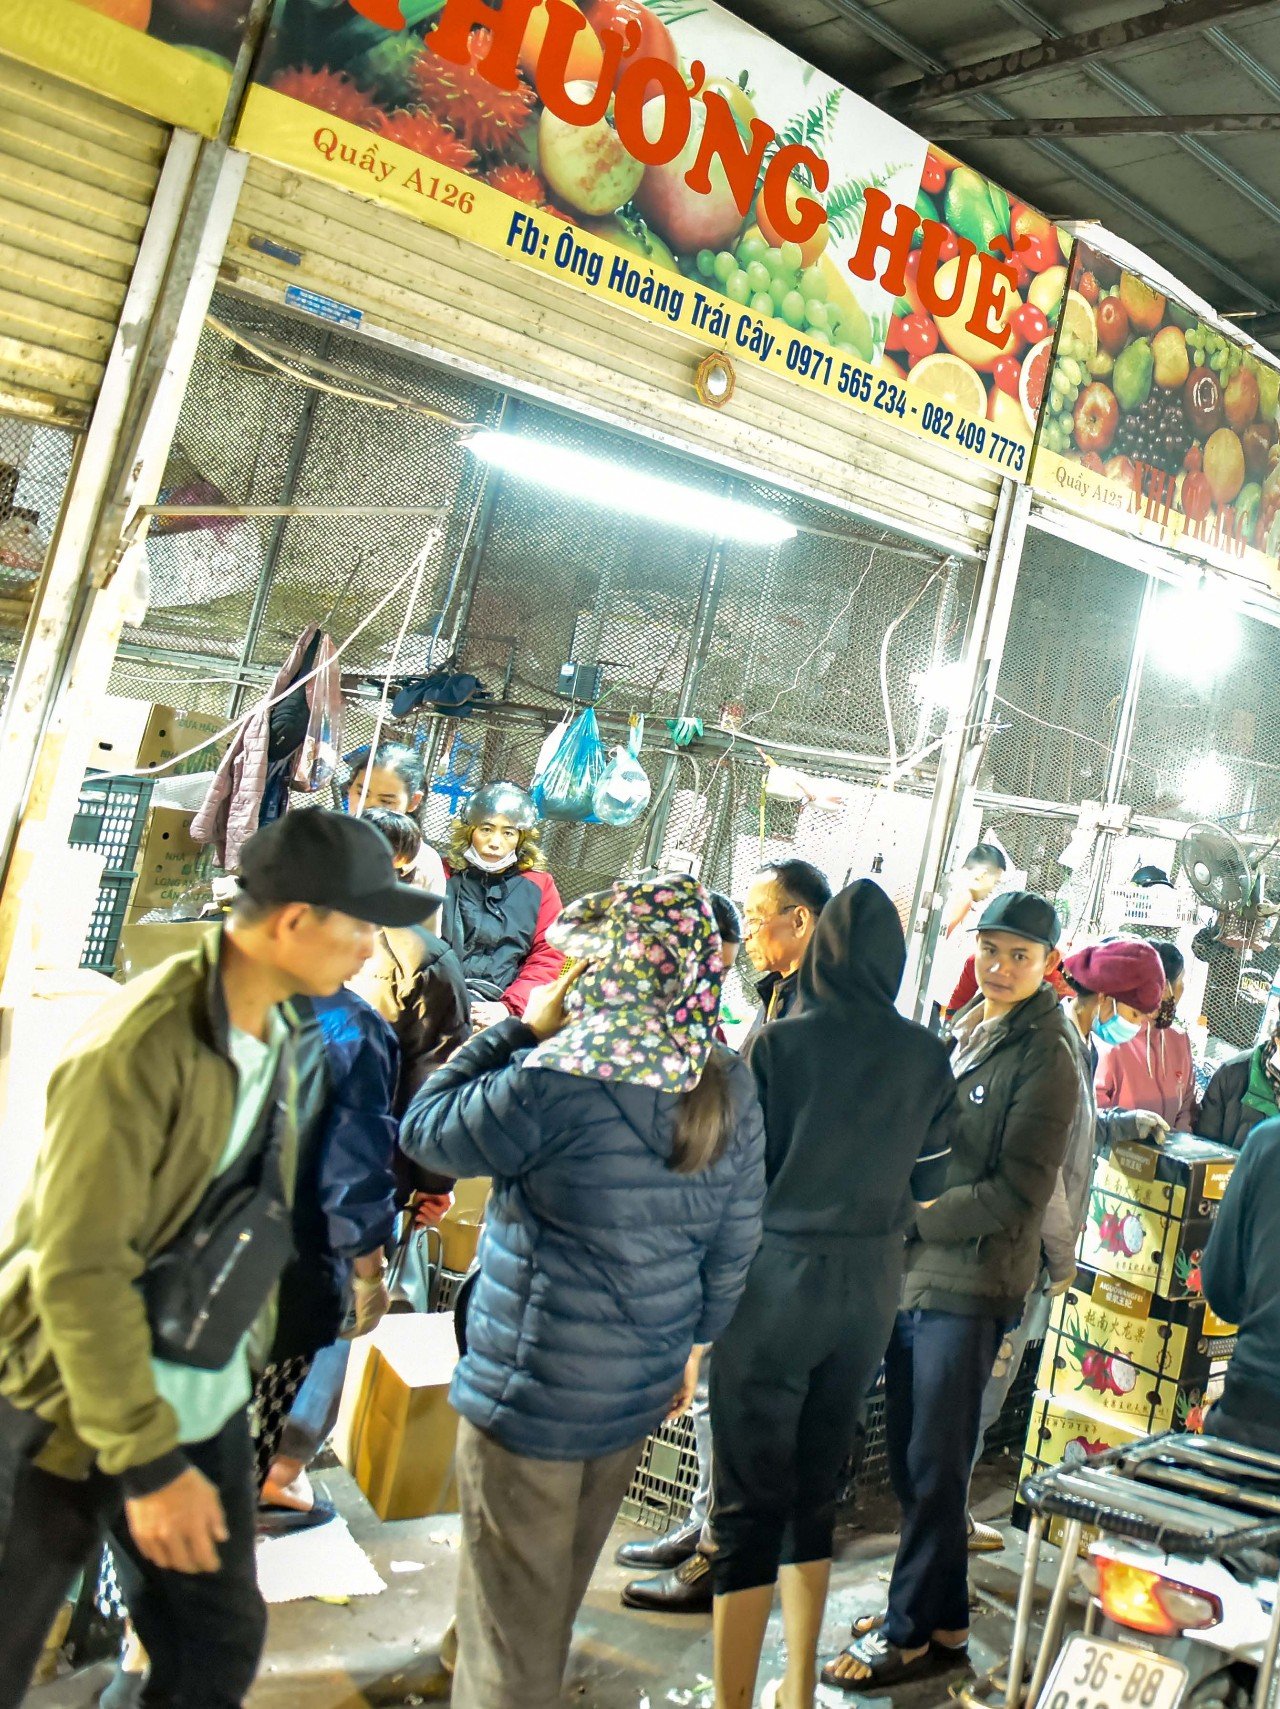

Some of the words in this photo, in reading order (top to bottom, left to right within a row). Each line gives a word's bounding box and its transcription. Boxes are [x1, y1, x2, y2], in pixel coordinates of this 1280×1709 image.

[347, 0, 829, 244] HƯƠNG
[313, 126, 397, 182] Quầy
[402, 168, 476, 215] A126
[506, 210, 550, 260] Fb:
[554, 226, 604, 286] Ông
[607, 255, 685, 322] Hoàng
[690, 292, 732, 340] Trái
[735, 314, 776, 362] Cây
[786, 339, 833, 386] 0971
[837, 363, 874, 403] 565
[873, 379, 907, 419] 234
[921, 402, 954, 440] 082
[955, 422, 987, 455] 409
[989, 432, 1026, 472] 7773
[1092, 485, 1123, 510] A125
[1073, 1646, 1165, 1707] 36-B8
